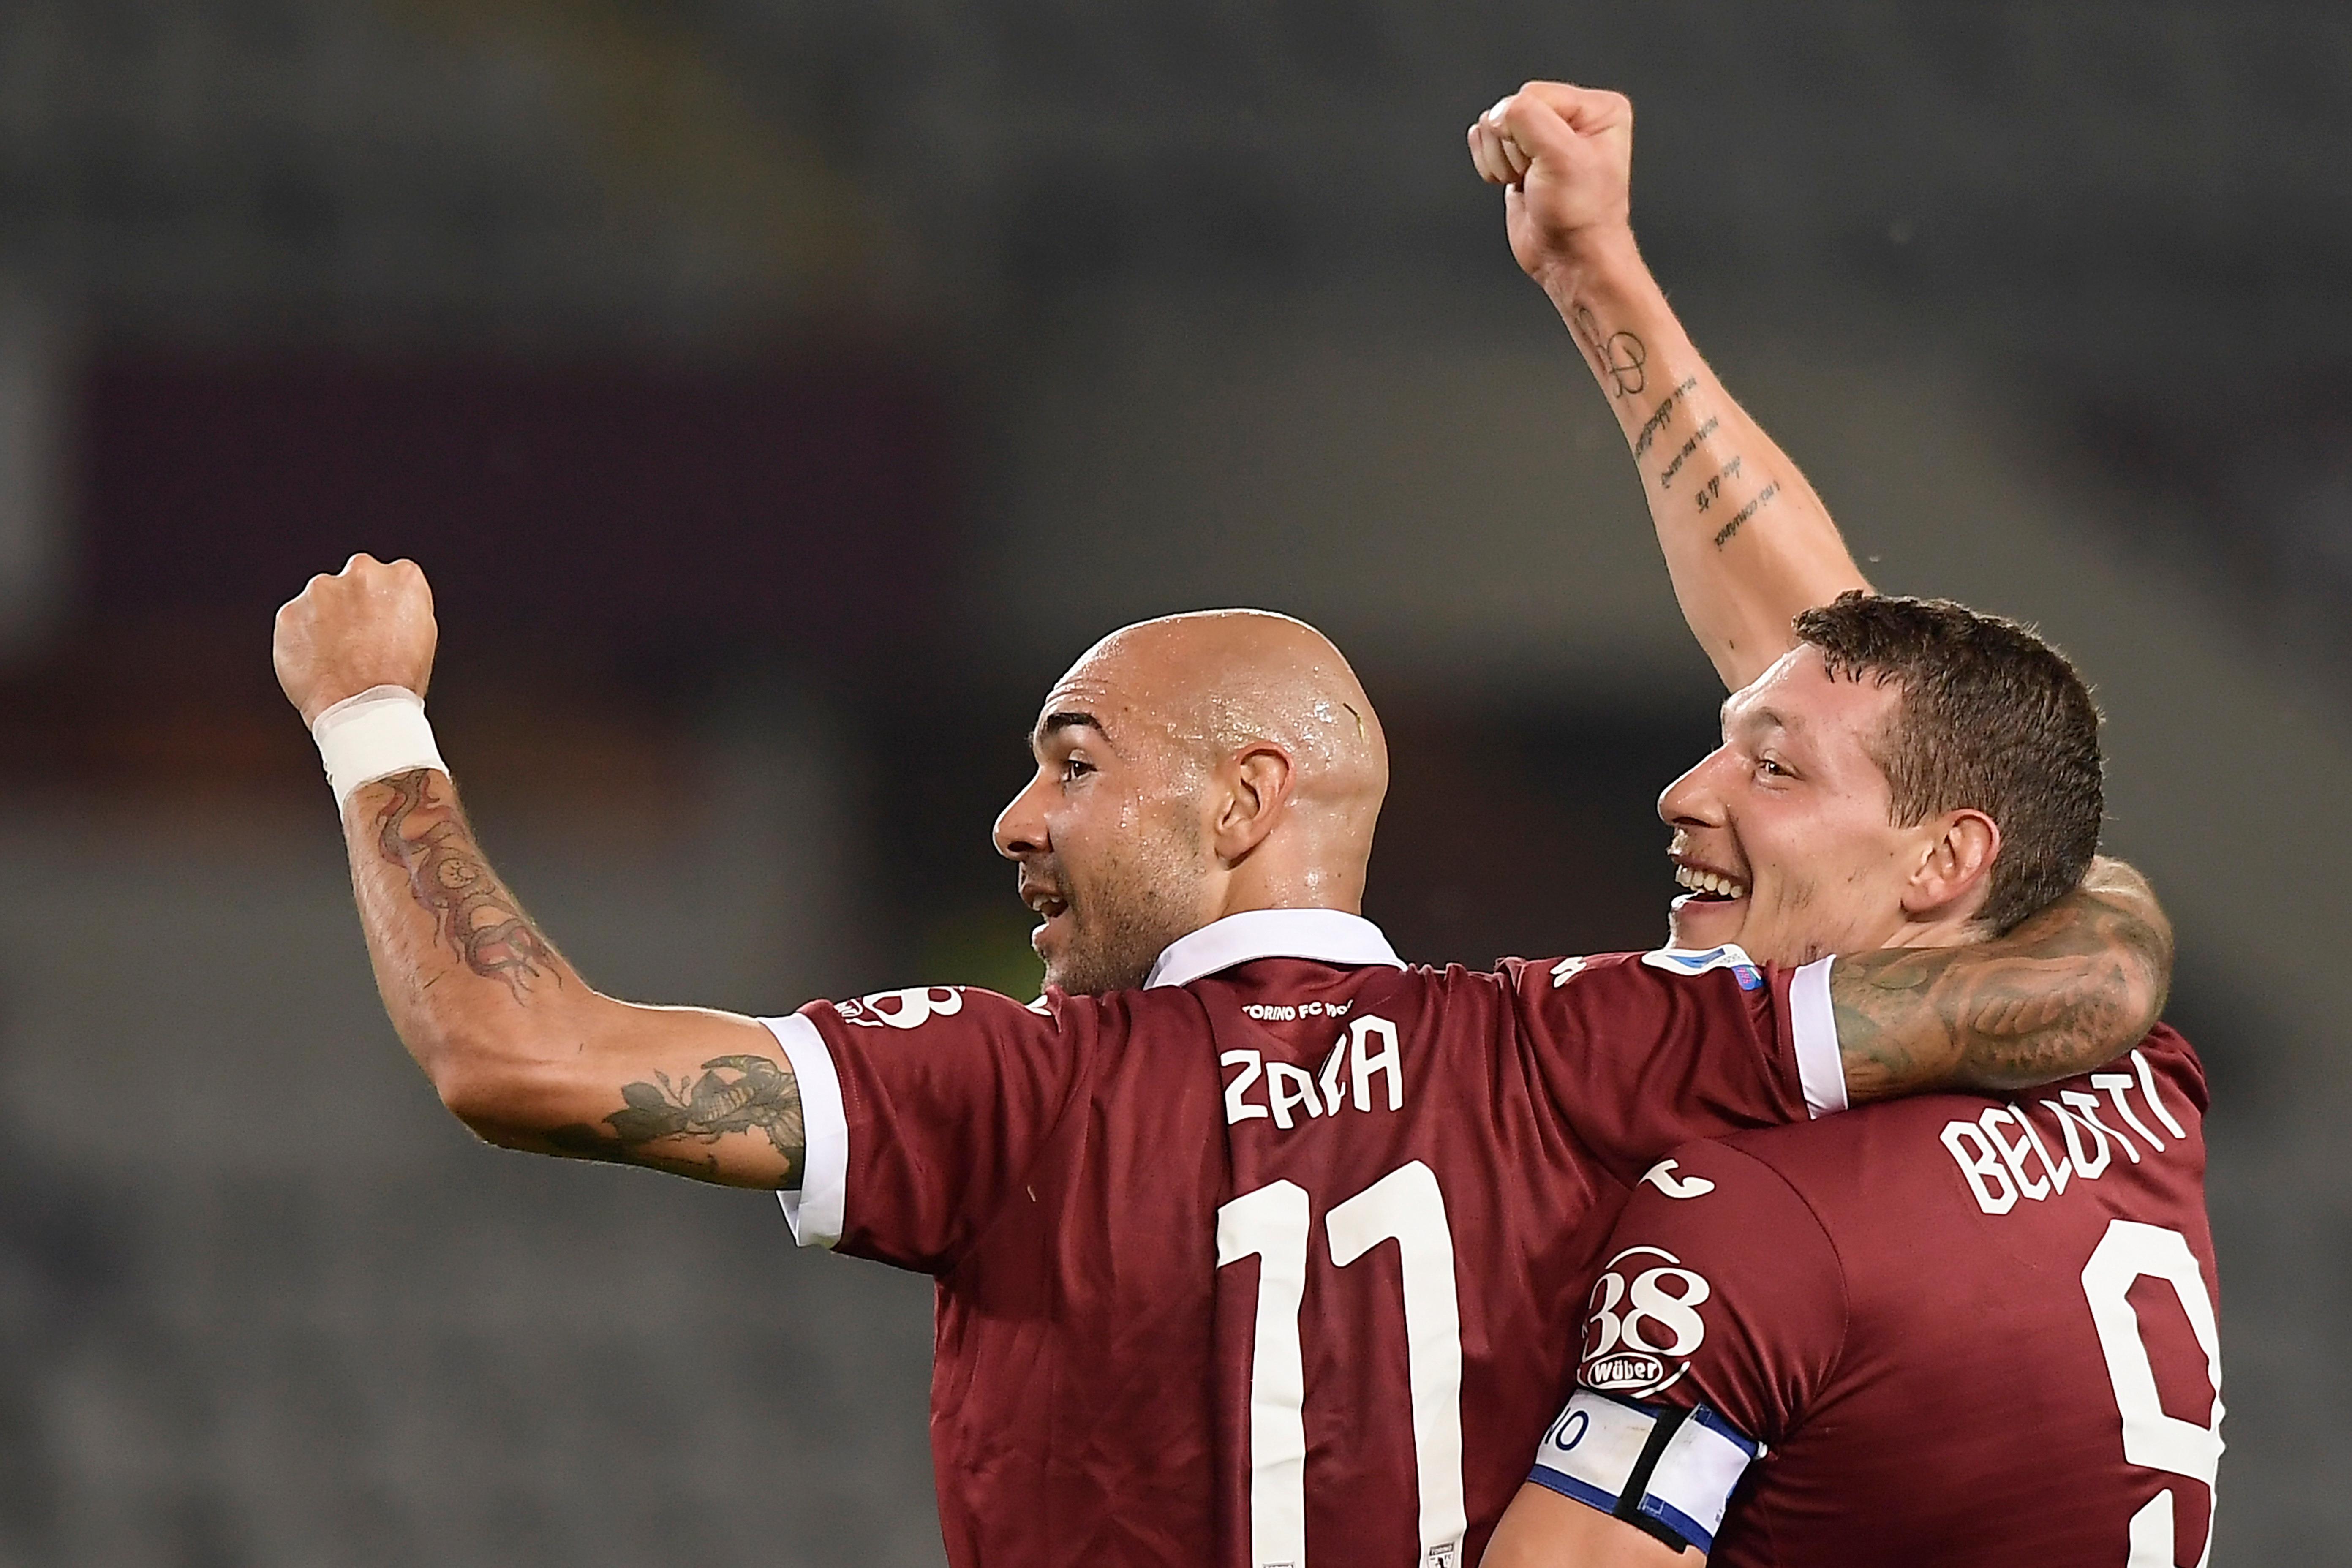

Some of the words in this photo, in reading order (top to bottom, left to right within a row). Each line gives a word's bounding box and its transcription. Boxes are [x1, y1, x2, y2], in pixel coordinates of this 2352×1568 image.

[1298, 1002, 1323, 1019] FC
[1940, 1050, 2186, 1214] BELOTTI
[1216, 1160, 1467, 1568] 11
[1594, 1359, 1658, 1383] Wüber
[2081, 1219, 2225, 1568] 9
